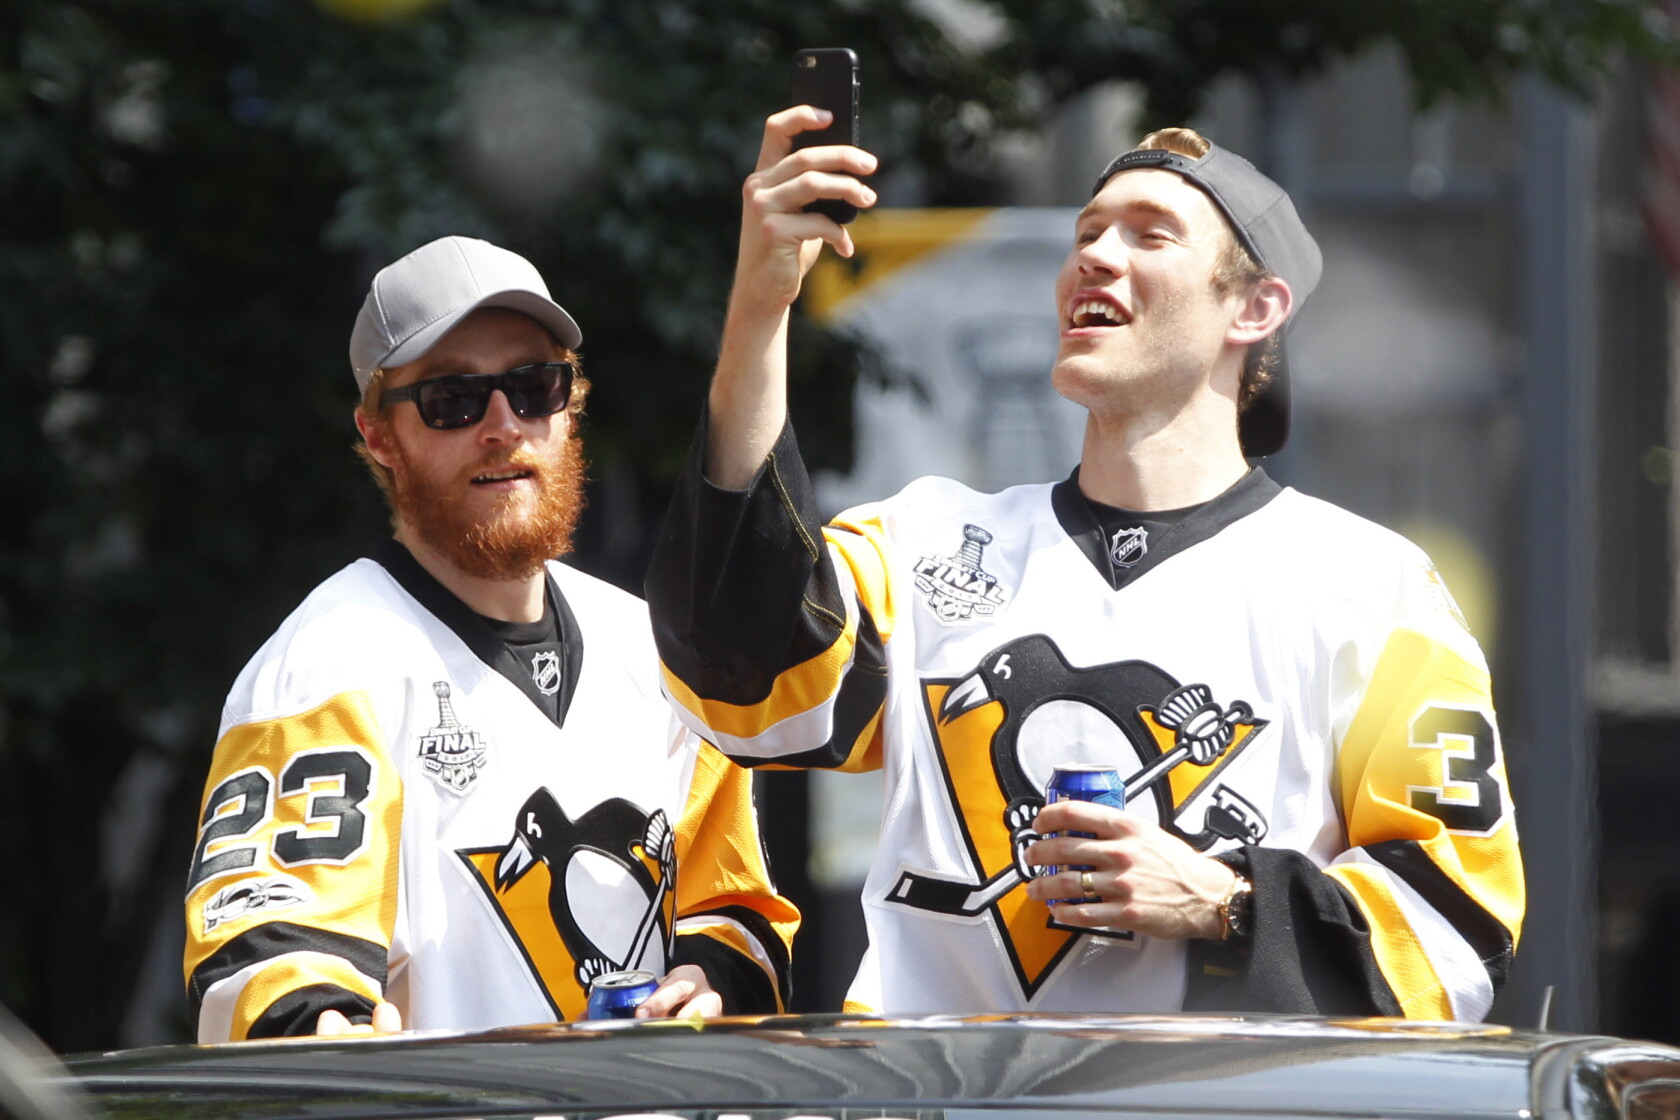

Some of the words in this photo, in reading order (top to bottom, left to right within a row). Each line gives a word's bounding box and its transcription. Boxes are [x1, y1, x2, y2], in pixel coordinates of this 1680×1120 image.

[1118, 537, 1141, 559] NHL
[914, 557, 1004, 605] FINAL
[420, 732, 486, 756] FINAL
[1407, 703, 1502, 836] 3
[186, 747, 374, 900] 23
